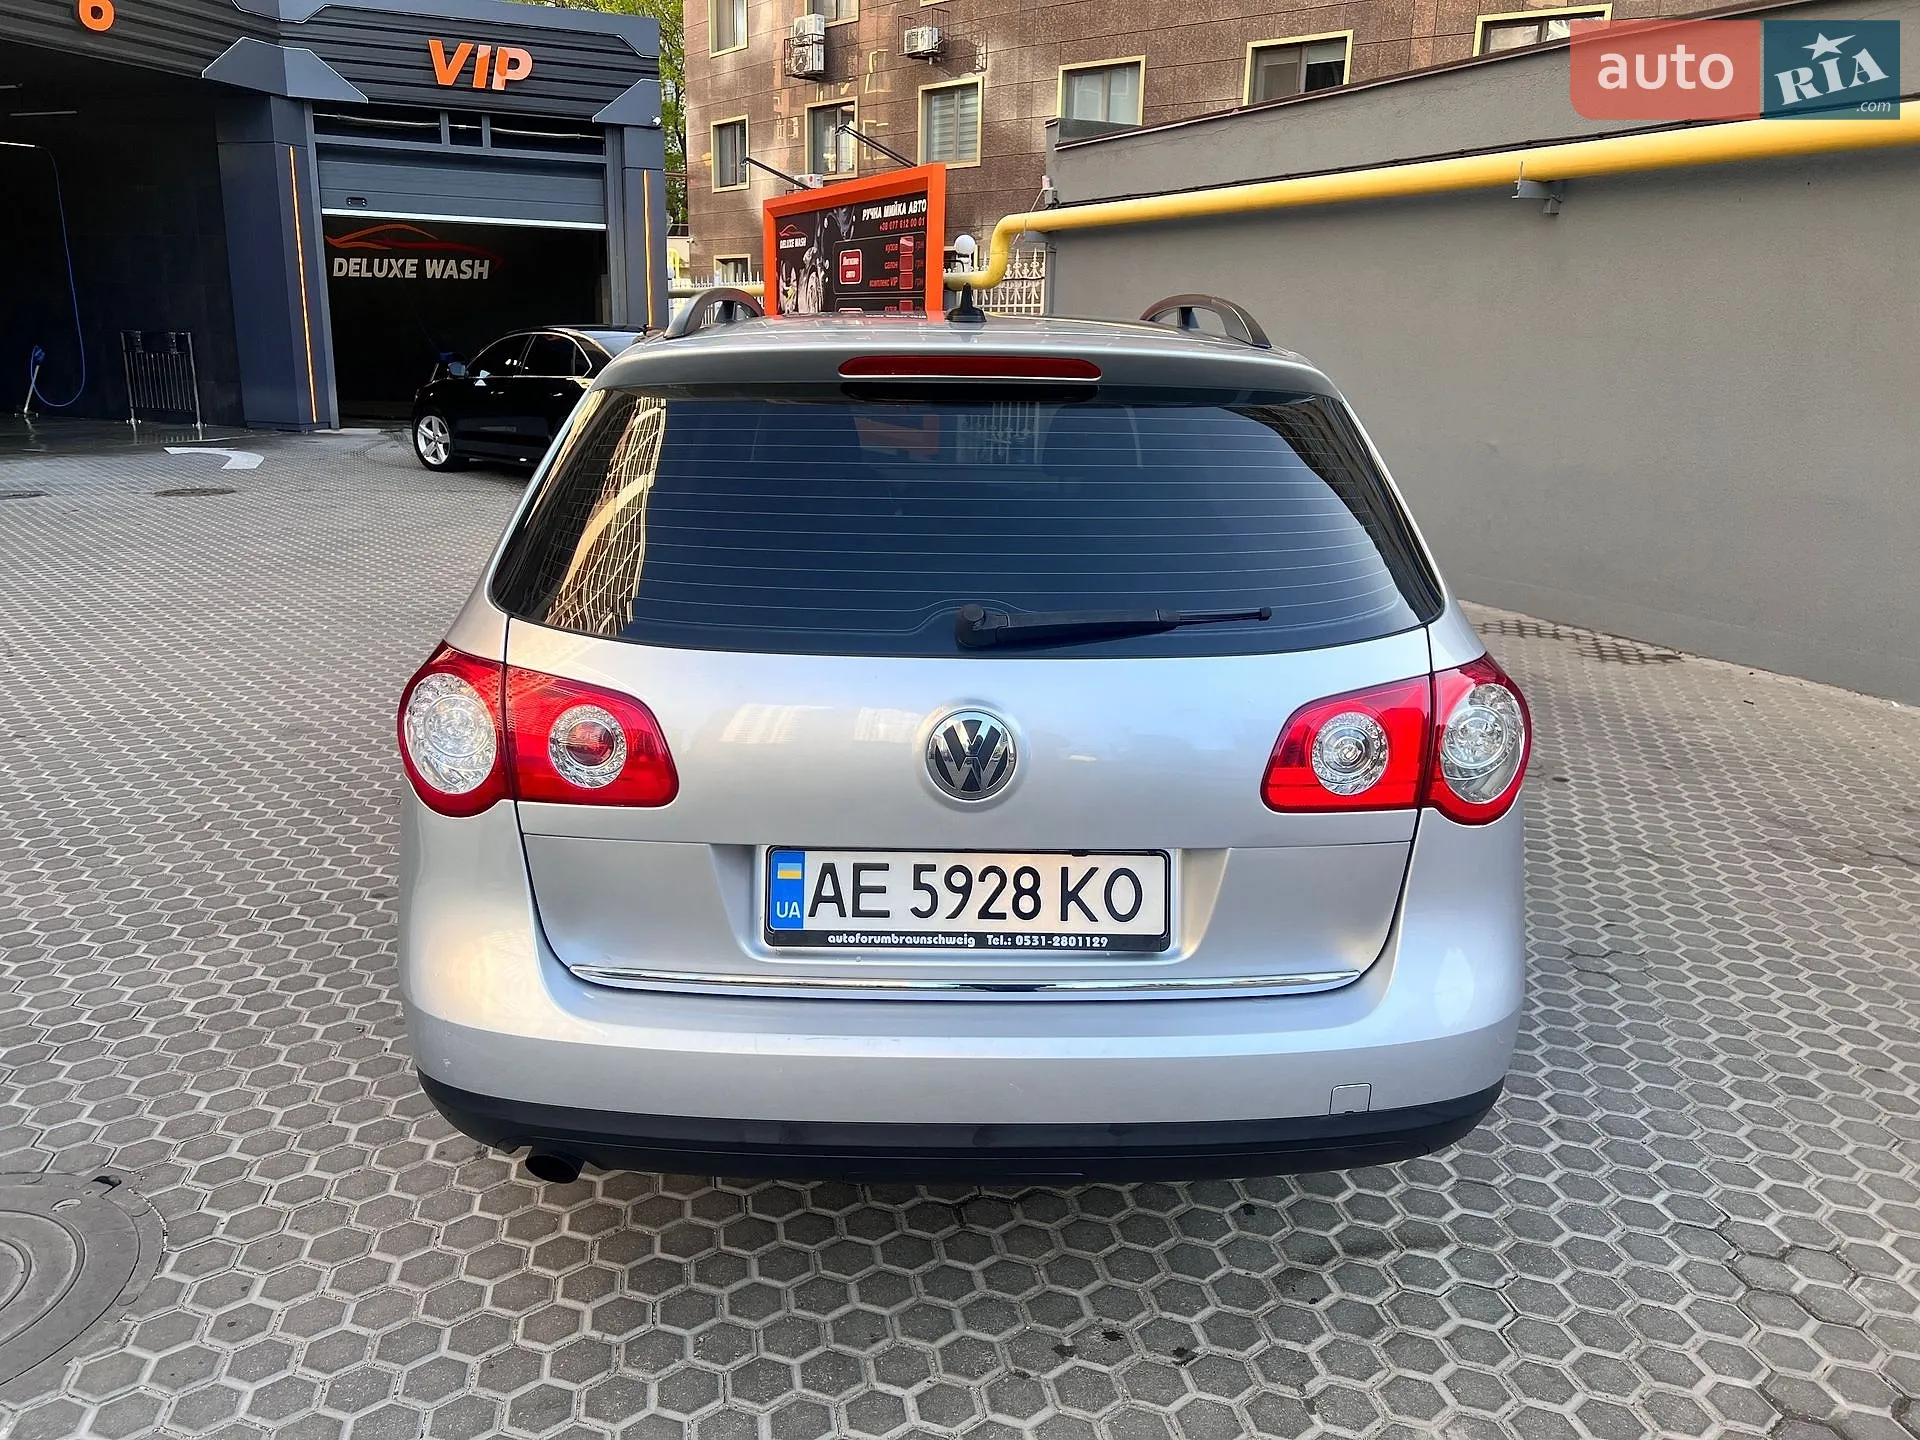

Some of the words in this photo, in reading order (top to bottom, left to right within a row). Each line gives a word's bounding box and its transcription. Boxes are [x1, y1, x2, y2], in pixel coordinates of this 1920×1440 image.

[78, 0, 115, 32] 6
[428, 38, 534, 91] VIP
[862, 206, 882, 221] РУЧКА
[883, 201, 907, 218] МИЙКА
[908, 199, 927, 214] АВТО
[332, 256, 417, 279] DELUXE
[425, 258, 490, 280] WASH
[807, 862, 891, 919] AE
[909, 863, 1042, 921] 5928
[1060, 866, 1143, 923] KO
[776, 902, 801, 918] UA
[827, 933, 976, 948] autoforumbraunschweig
[986, 934, 1012, 947] Tel.:
[1015, 935, 1108, 948] 0531-2801129
